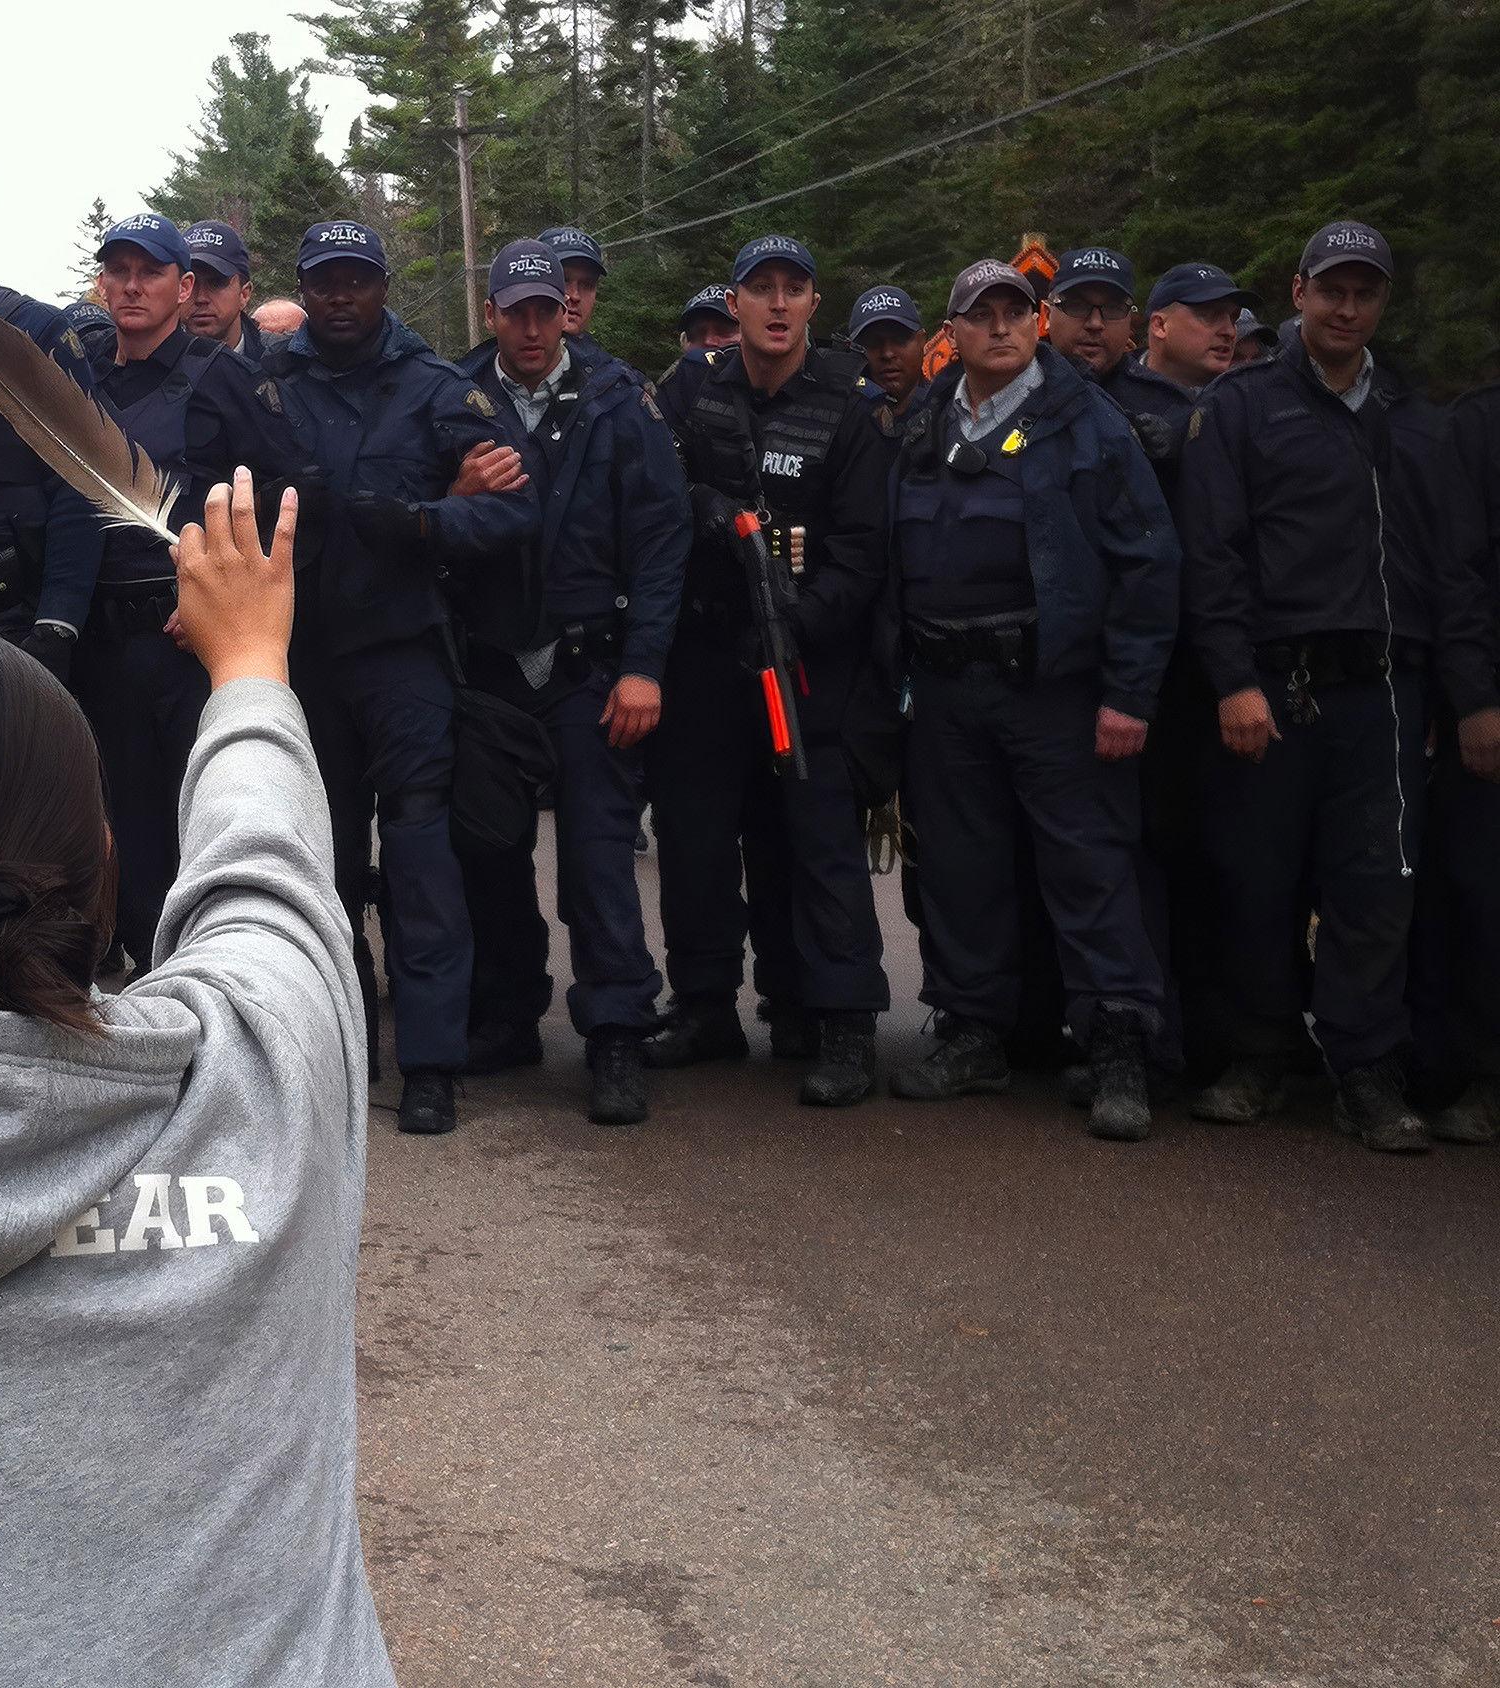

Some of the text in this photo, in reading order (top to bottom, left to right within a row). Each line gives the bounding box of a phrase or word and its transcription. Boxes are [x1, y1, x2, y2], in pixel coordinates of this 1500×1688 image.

[319, 228, 367, 244] POLICE
[1327, 231, 1377, 249] POLICE
[753, 238, 799, 255] POLICE
[509, 259, 552, 275] POLICE
[1073, 251, 1120, 269] POLICE
[861, 294, 901, 313] POLICE
[762, 451, 804, 478] POLICE
